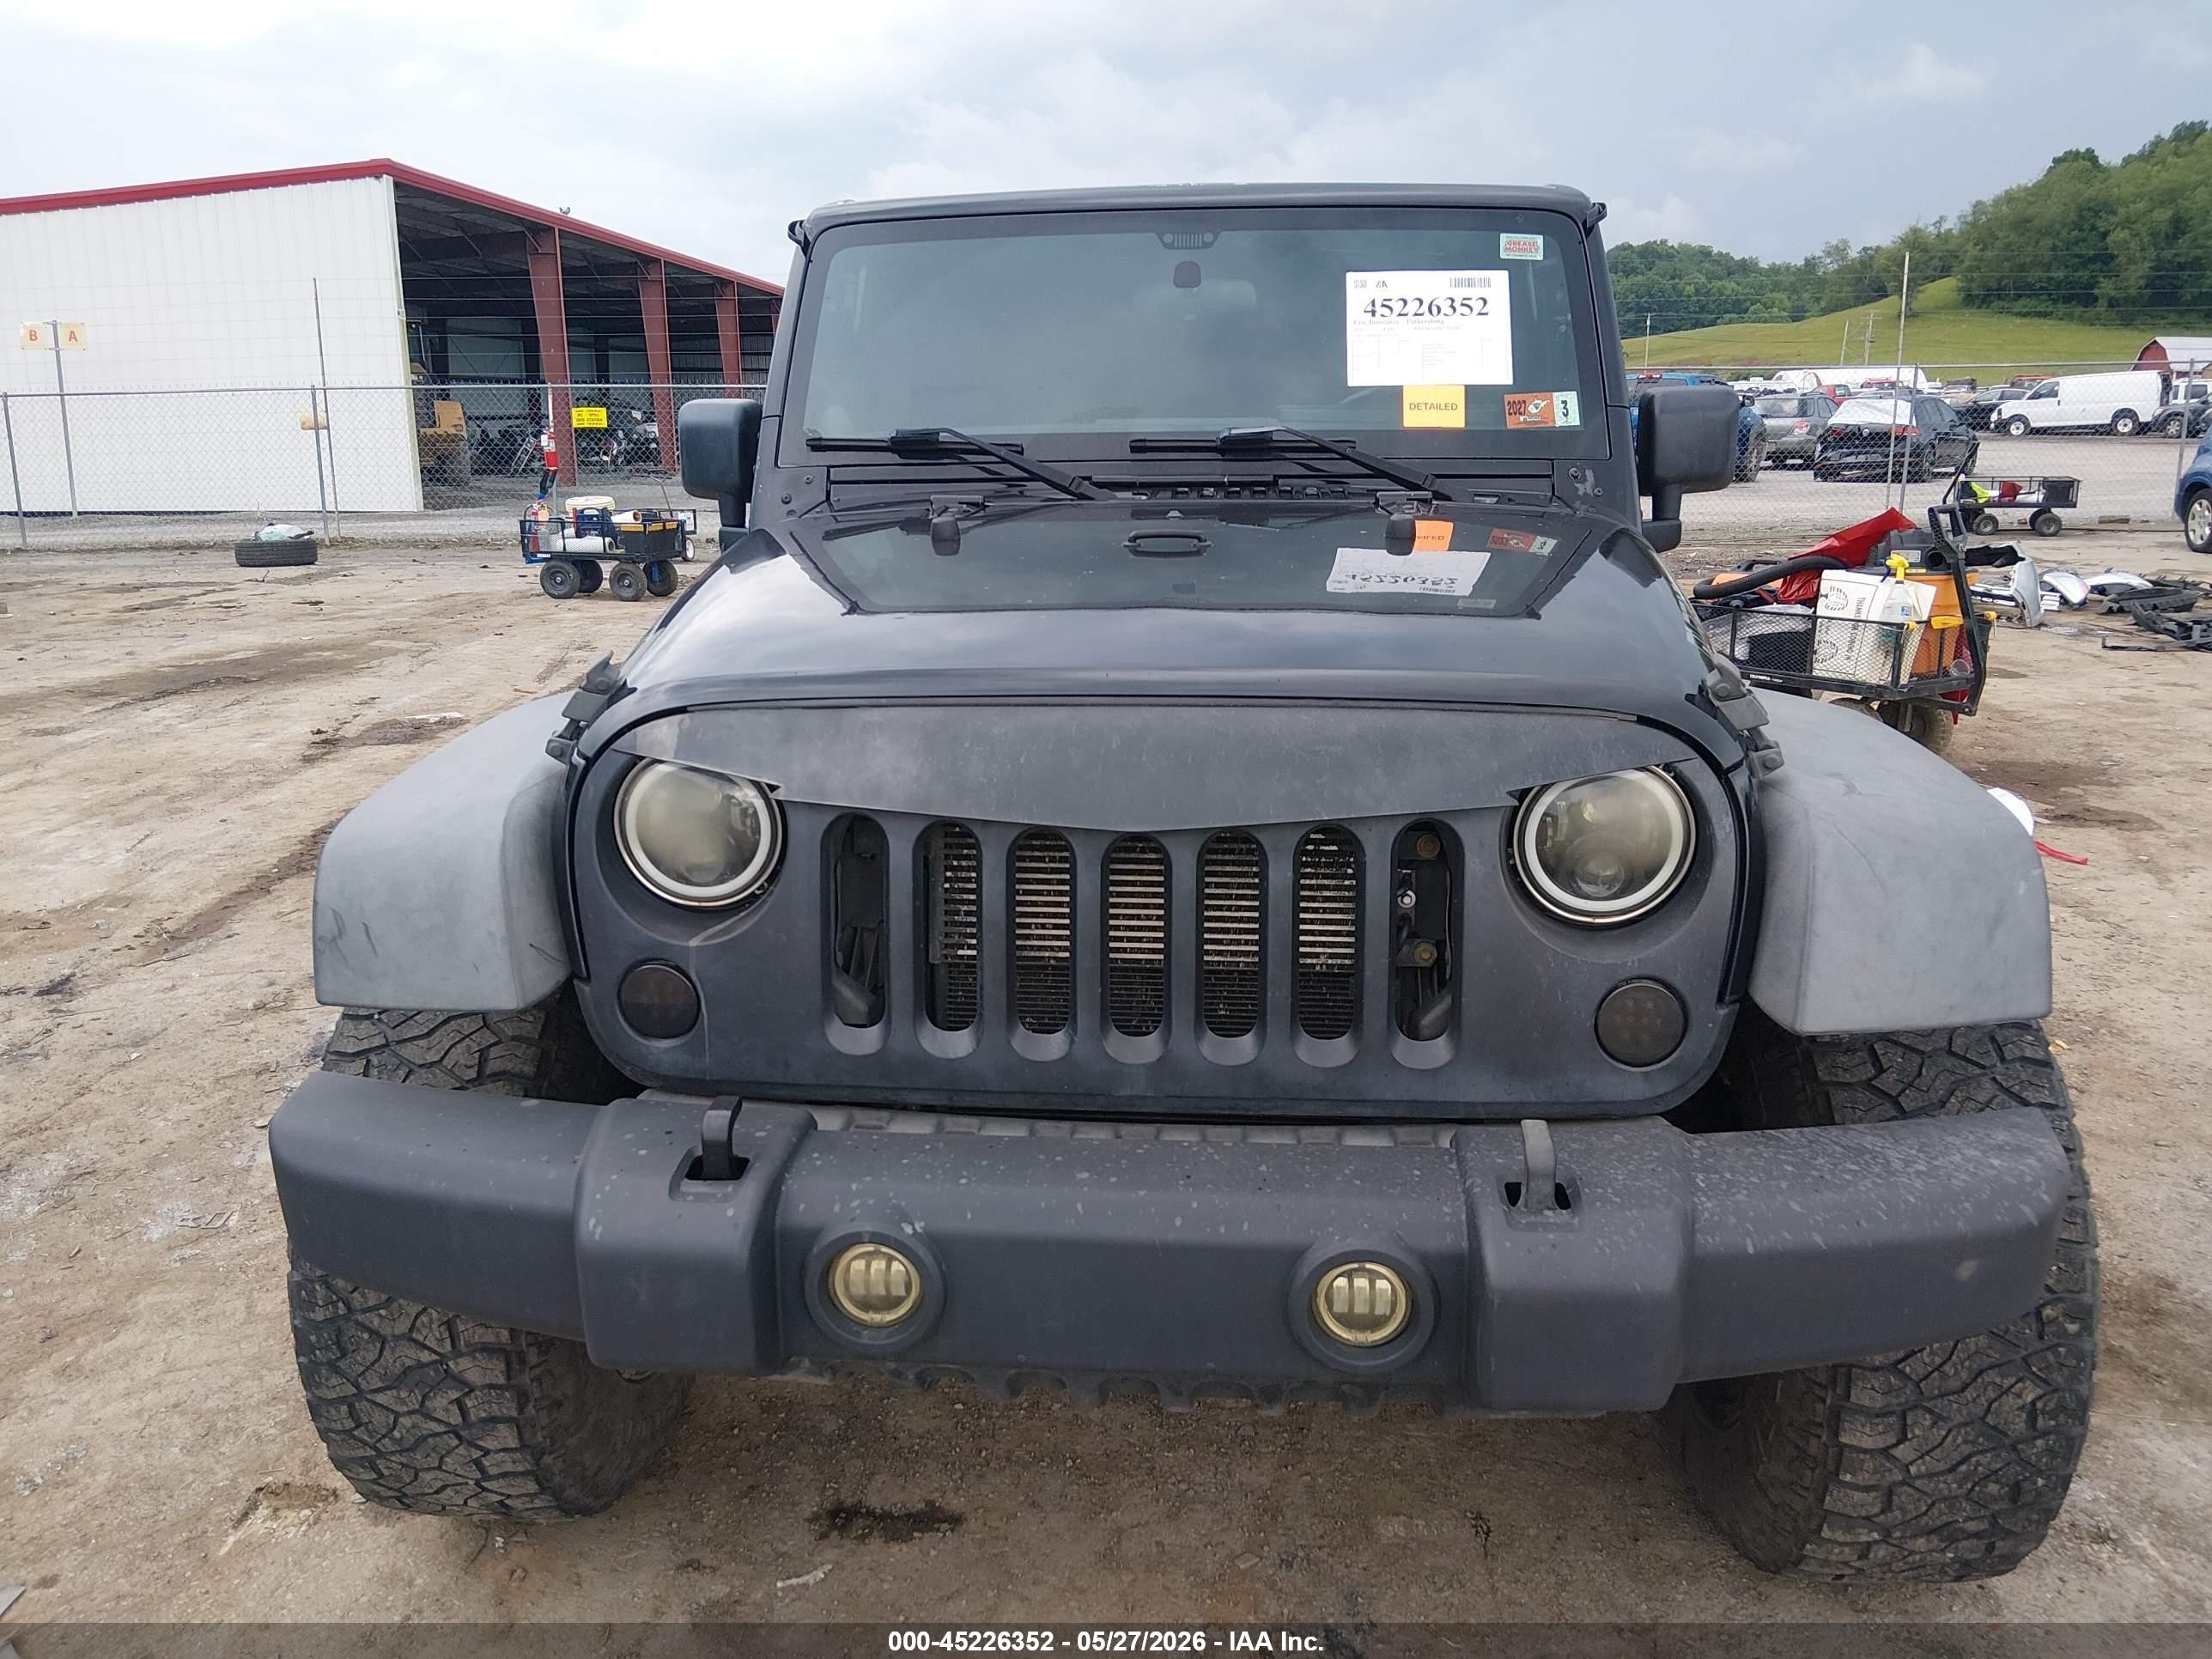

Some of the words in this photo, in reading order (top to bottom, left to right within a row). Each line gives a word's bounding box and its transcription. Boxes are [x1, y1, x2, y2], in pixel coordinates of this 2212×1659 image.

[1364, 296, 1490, 318] 45226352
[28, 330, 38, 341] B
[68, 331, 78, 342] A
[1409, 402, 1458, 410] DETAILED
[1507, 399, 1527, 416] 2027
[1560, 399, 1570, 417] 3
